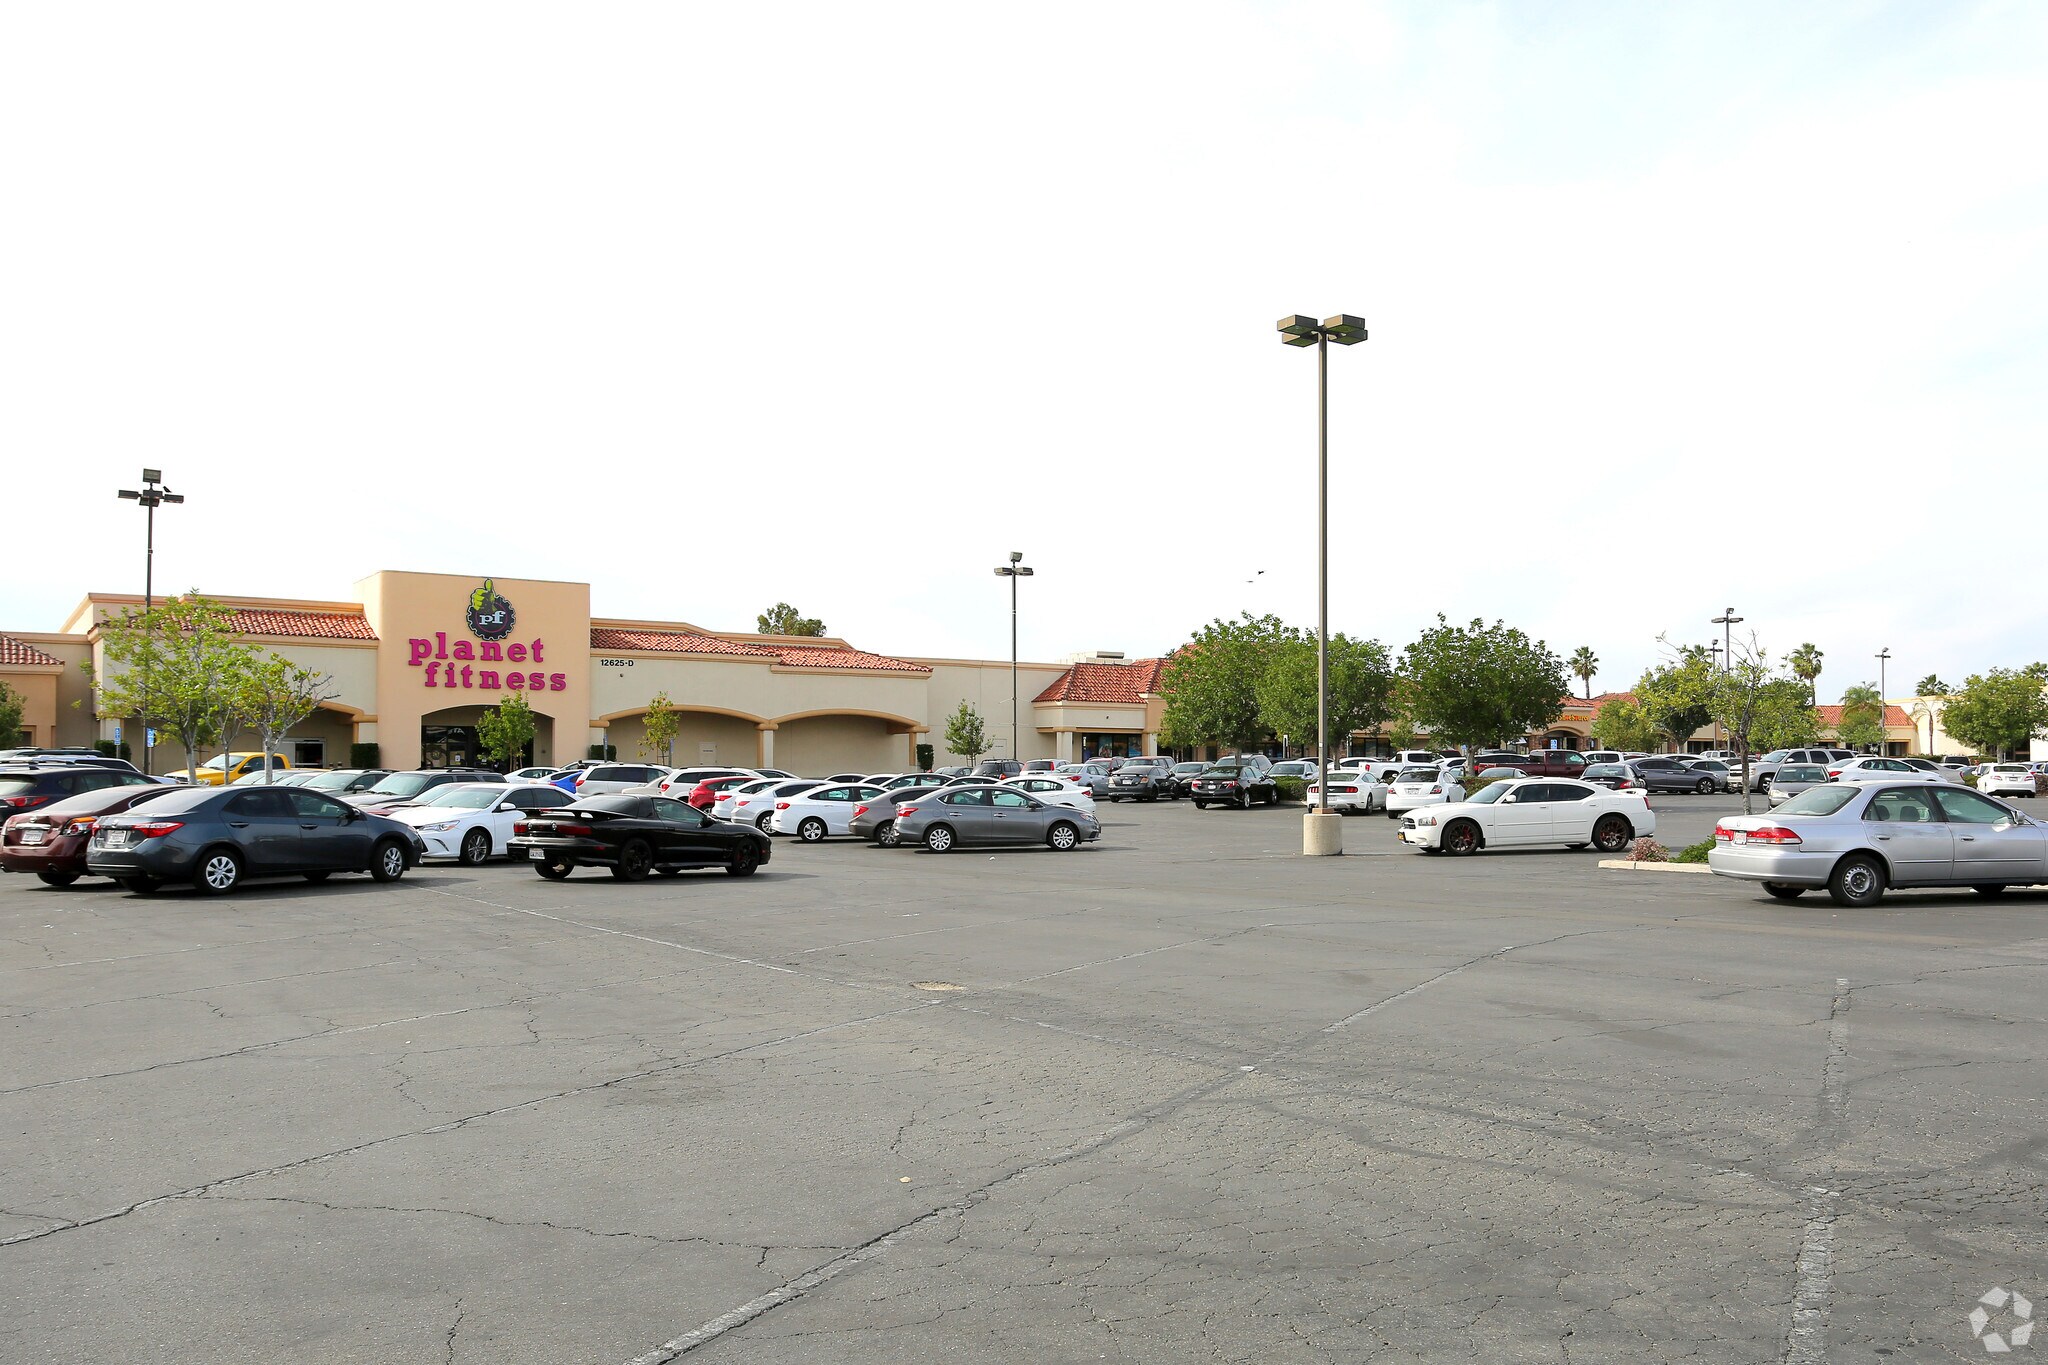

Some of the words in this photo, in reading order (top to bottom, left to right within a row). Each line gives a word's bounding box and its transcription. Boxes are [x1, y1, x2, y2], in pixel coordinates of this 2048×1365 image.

[479, 610, 506, 626] pf
[408, 631, 544, 666] planet
[600, 659, 634, 667] 12625-D
[425, 661, 567, 691] fitness
